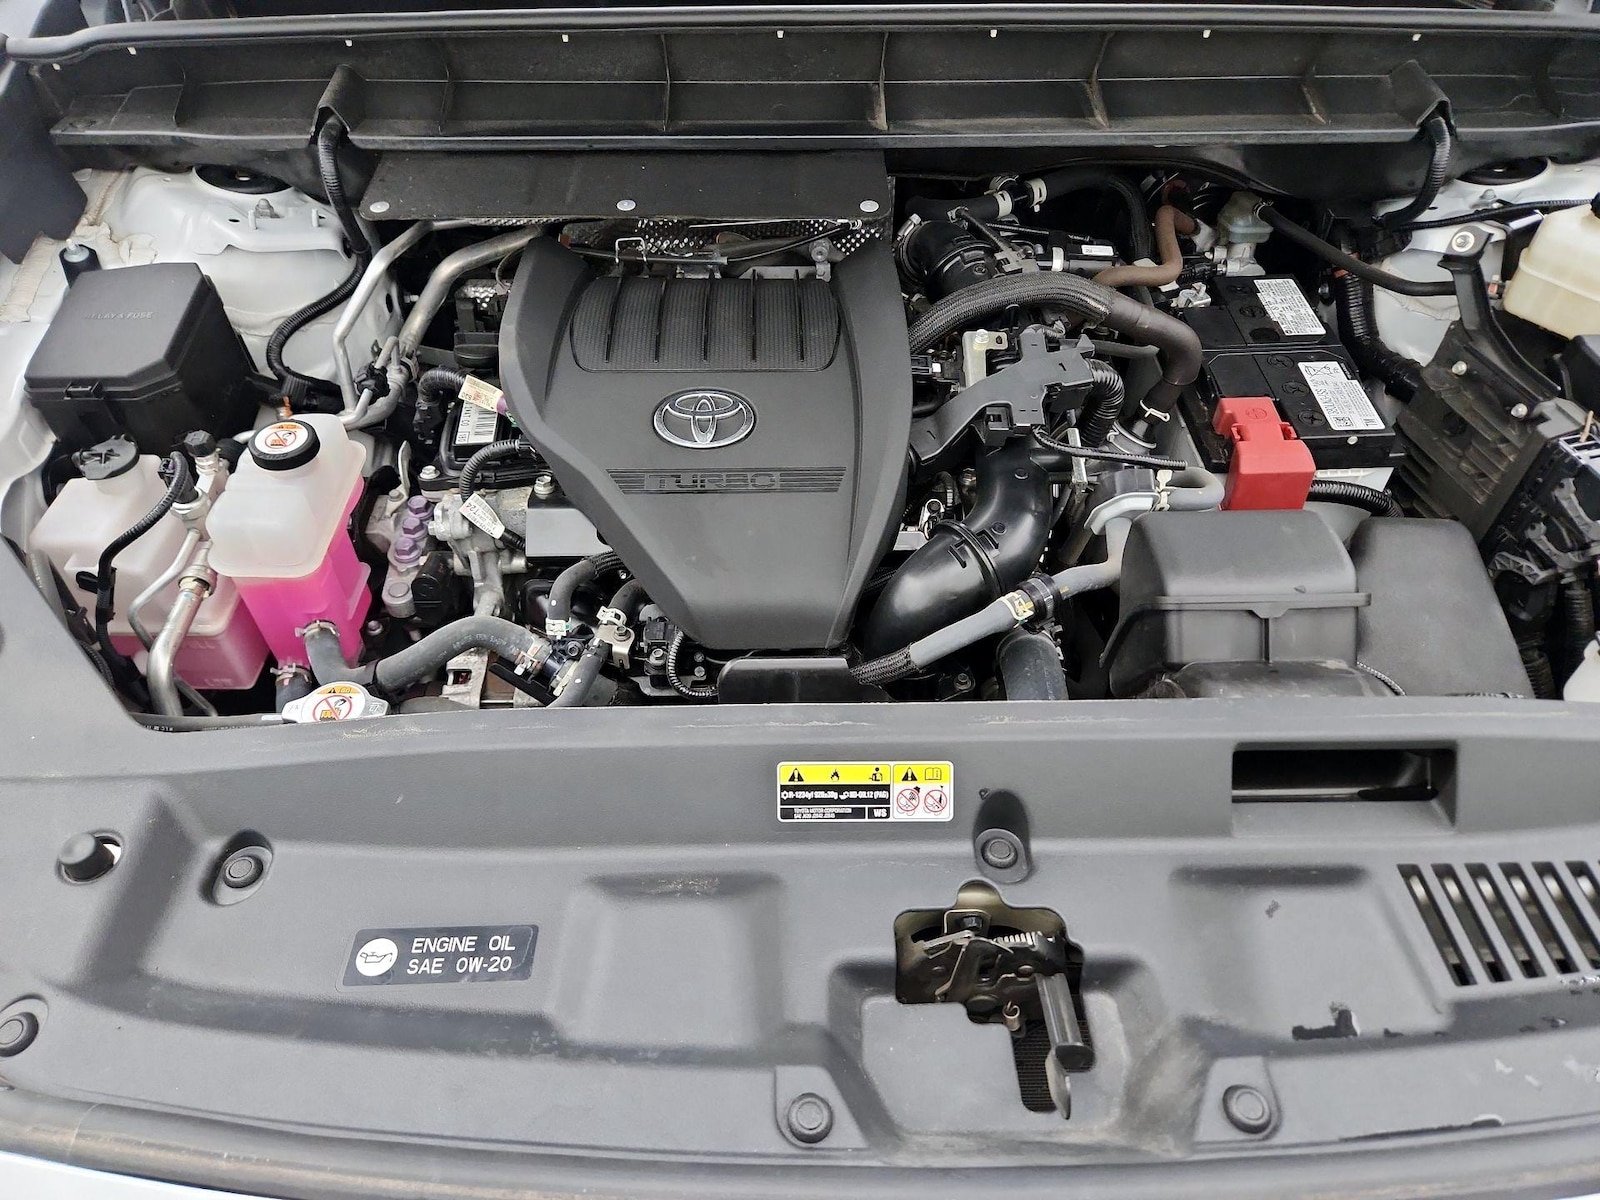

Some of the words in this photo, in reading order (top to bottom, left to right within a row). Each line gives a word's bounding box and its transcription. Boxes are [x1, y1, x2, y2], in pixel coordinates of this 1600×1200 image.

[126, 311, 154, 320] FUSE
[648, 472, 776, 490] TURBO
[873, 809, 887, 818] WS
[411, 936, 478, 953] ENGINE
[488, 935, 516, 951] OIL
[406, 958, 445, 975] SAE
[455, 956, 513, 973] 0W-20
